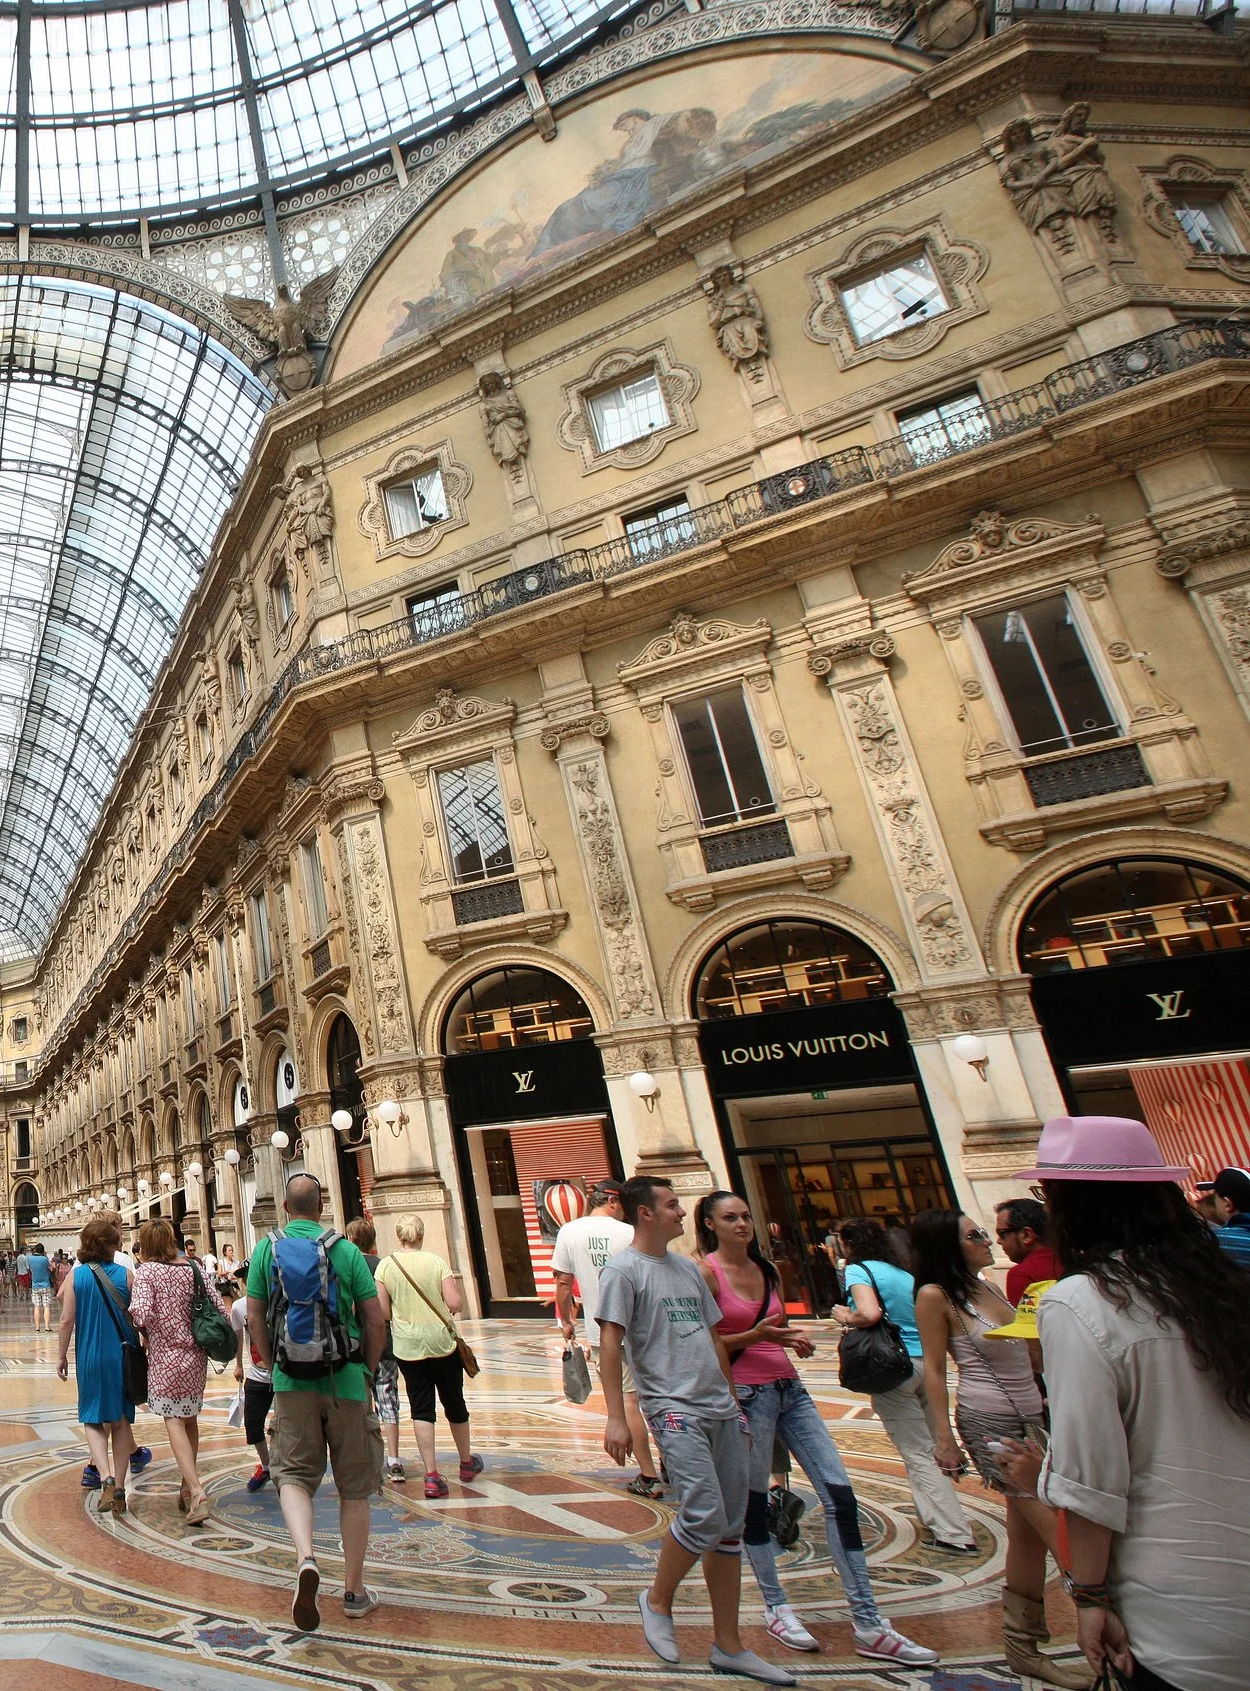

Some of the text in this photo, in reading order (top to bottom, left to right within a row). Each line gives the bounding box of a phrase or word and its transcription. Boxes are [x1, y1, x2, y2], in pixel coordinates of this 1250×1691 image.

[1146, 990, 1191, 1021] LV
[721, 1030, 890, 1065] LOUIS VUITTON
[512, 1071, 536, 1093] LV
[588, 1237, 609, 1250] JUST
